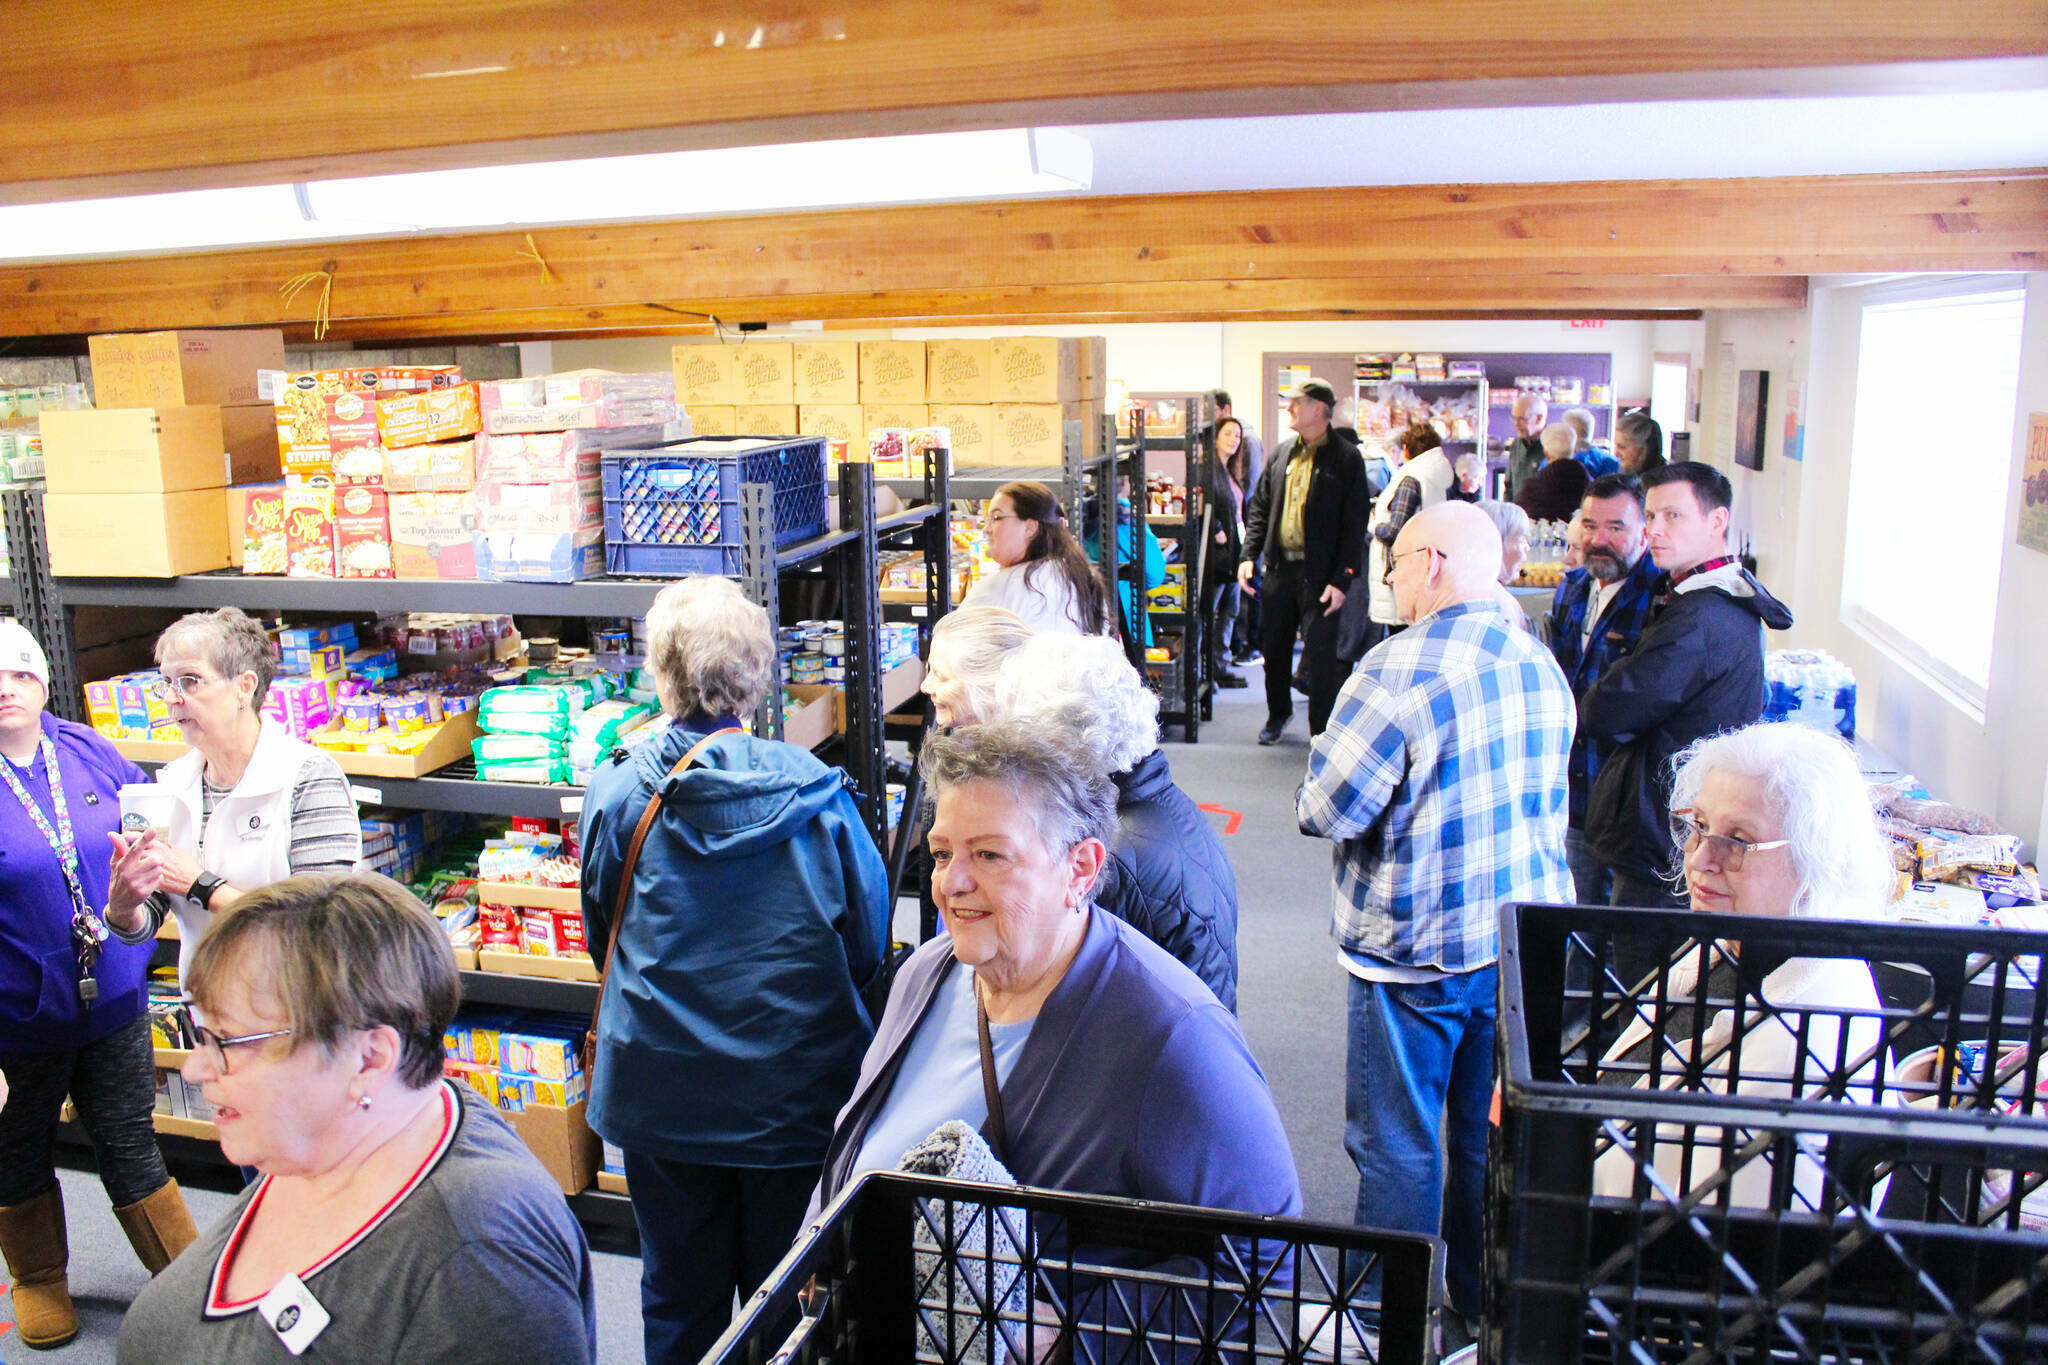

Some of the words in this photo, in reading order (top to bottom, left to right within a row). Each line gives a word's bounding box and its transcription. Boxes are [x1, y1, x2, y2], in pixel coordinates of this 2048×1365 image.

[289, 510, 325, 537] Stove
[303, 524, 321, 543] Top
[522, 823, 540, 833] RICE
[562, 919, 581, 928] RICE
[563, 929, 582, 938] RONI
